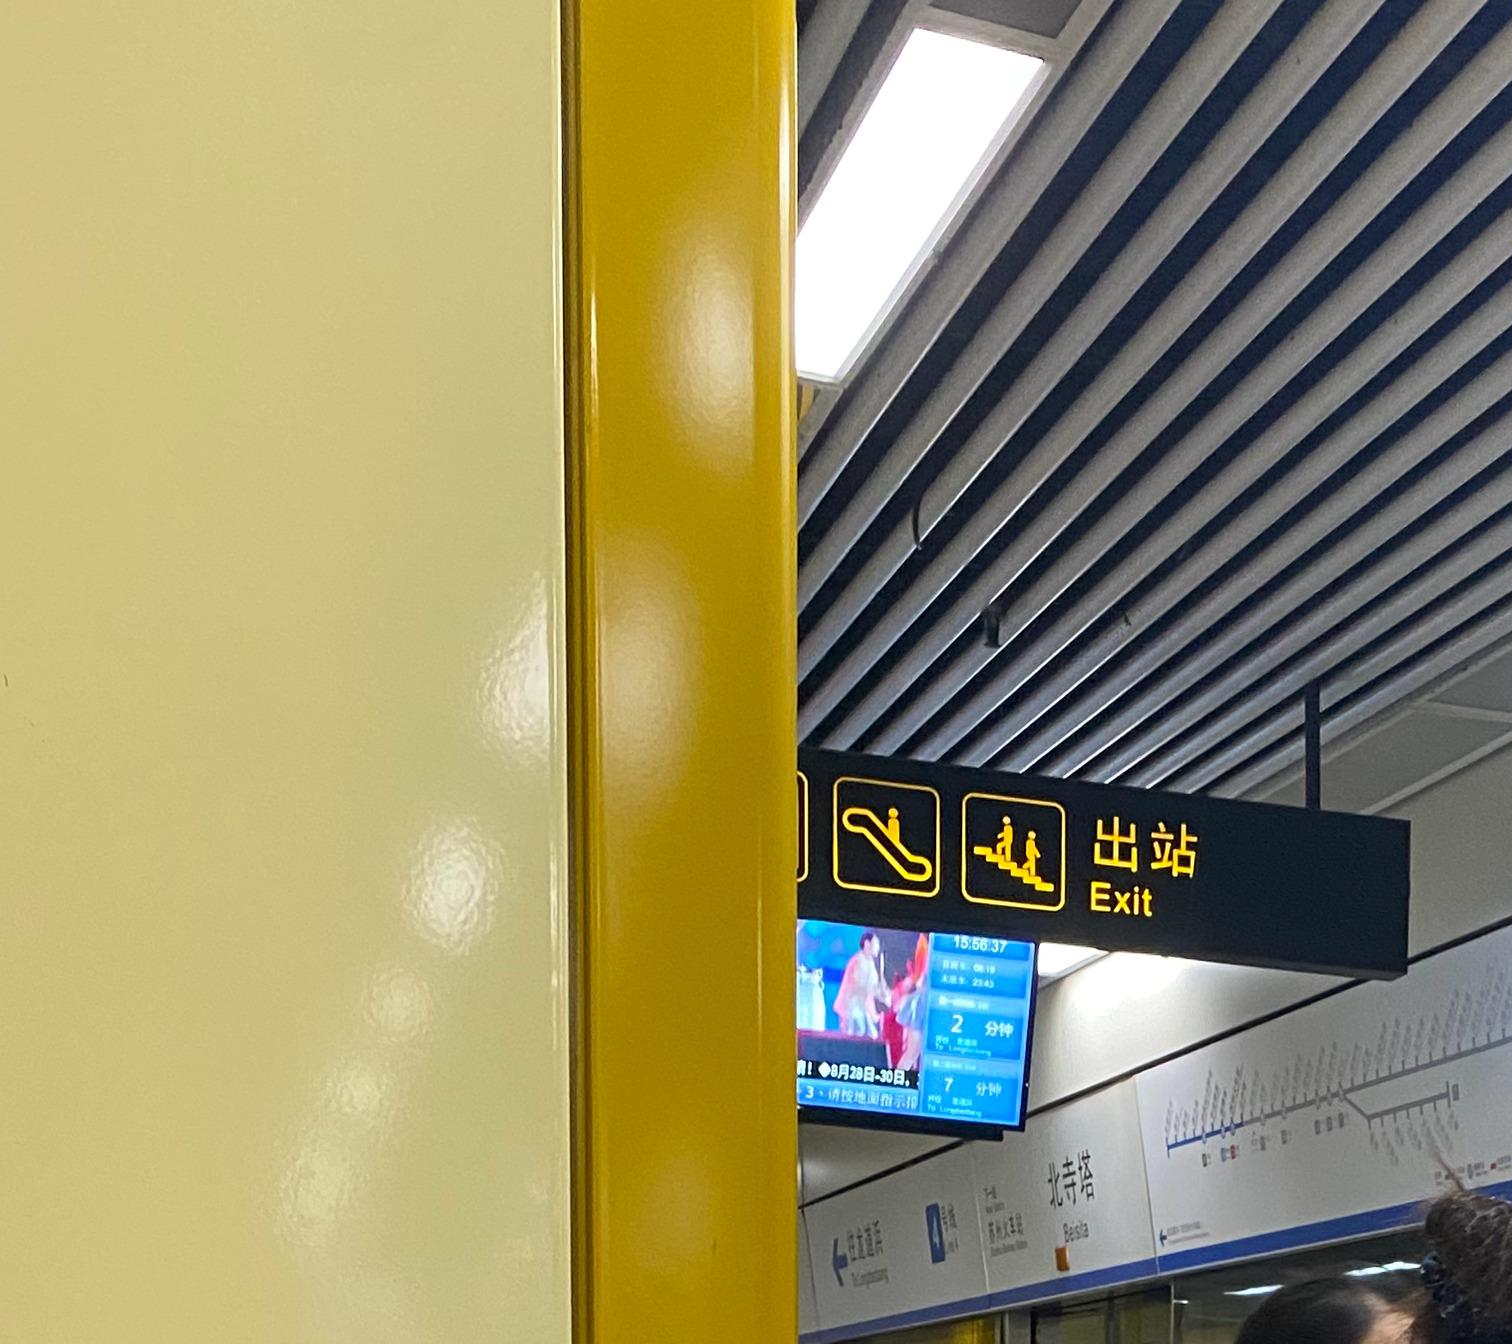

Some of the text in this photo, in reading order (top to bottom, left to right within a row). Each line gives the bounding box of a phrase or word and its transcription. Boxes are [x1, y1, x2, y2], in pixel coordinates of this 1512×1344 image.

[1093, 815, 1199, 879] 出站
[1090, 880, 1153, 917] Exit
[950, 1014, 1014, 1039] 2 分钟
[944, 1076, 1002, 1097] 7 分钟
[1047, 1149, 1095, 1210] 北寺塔
